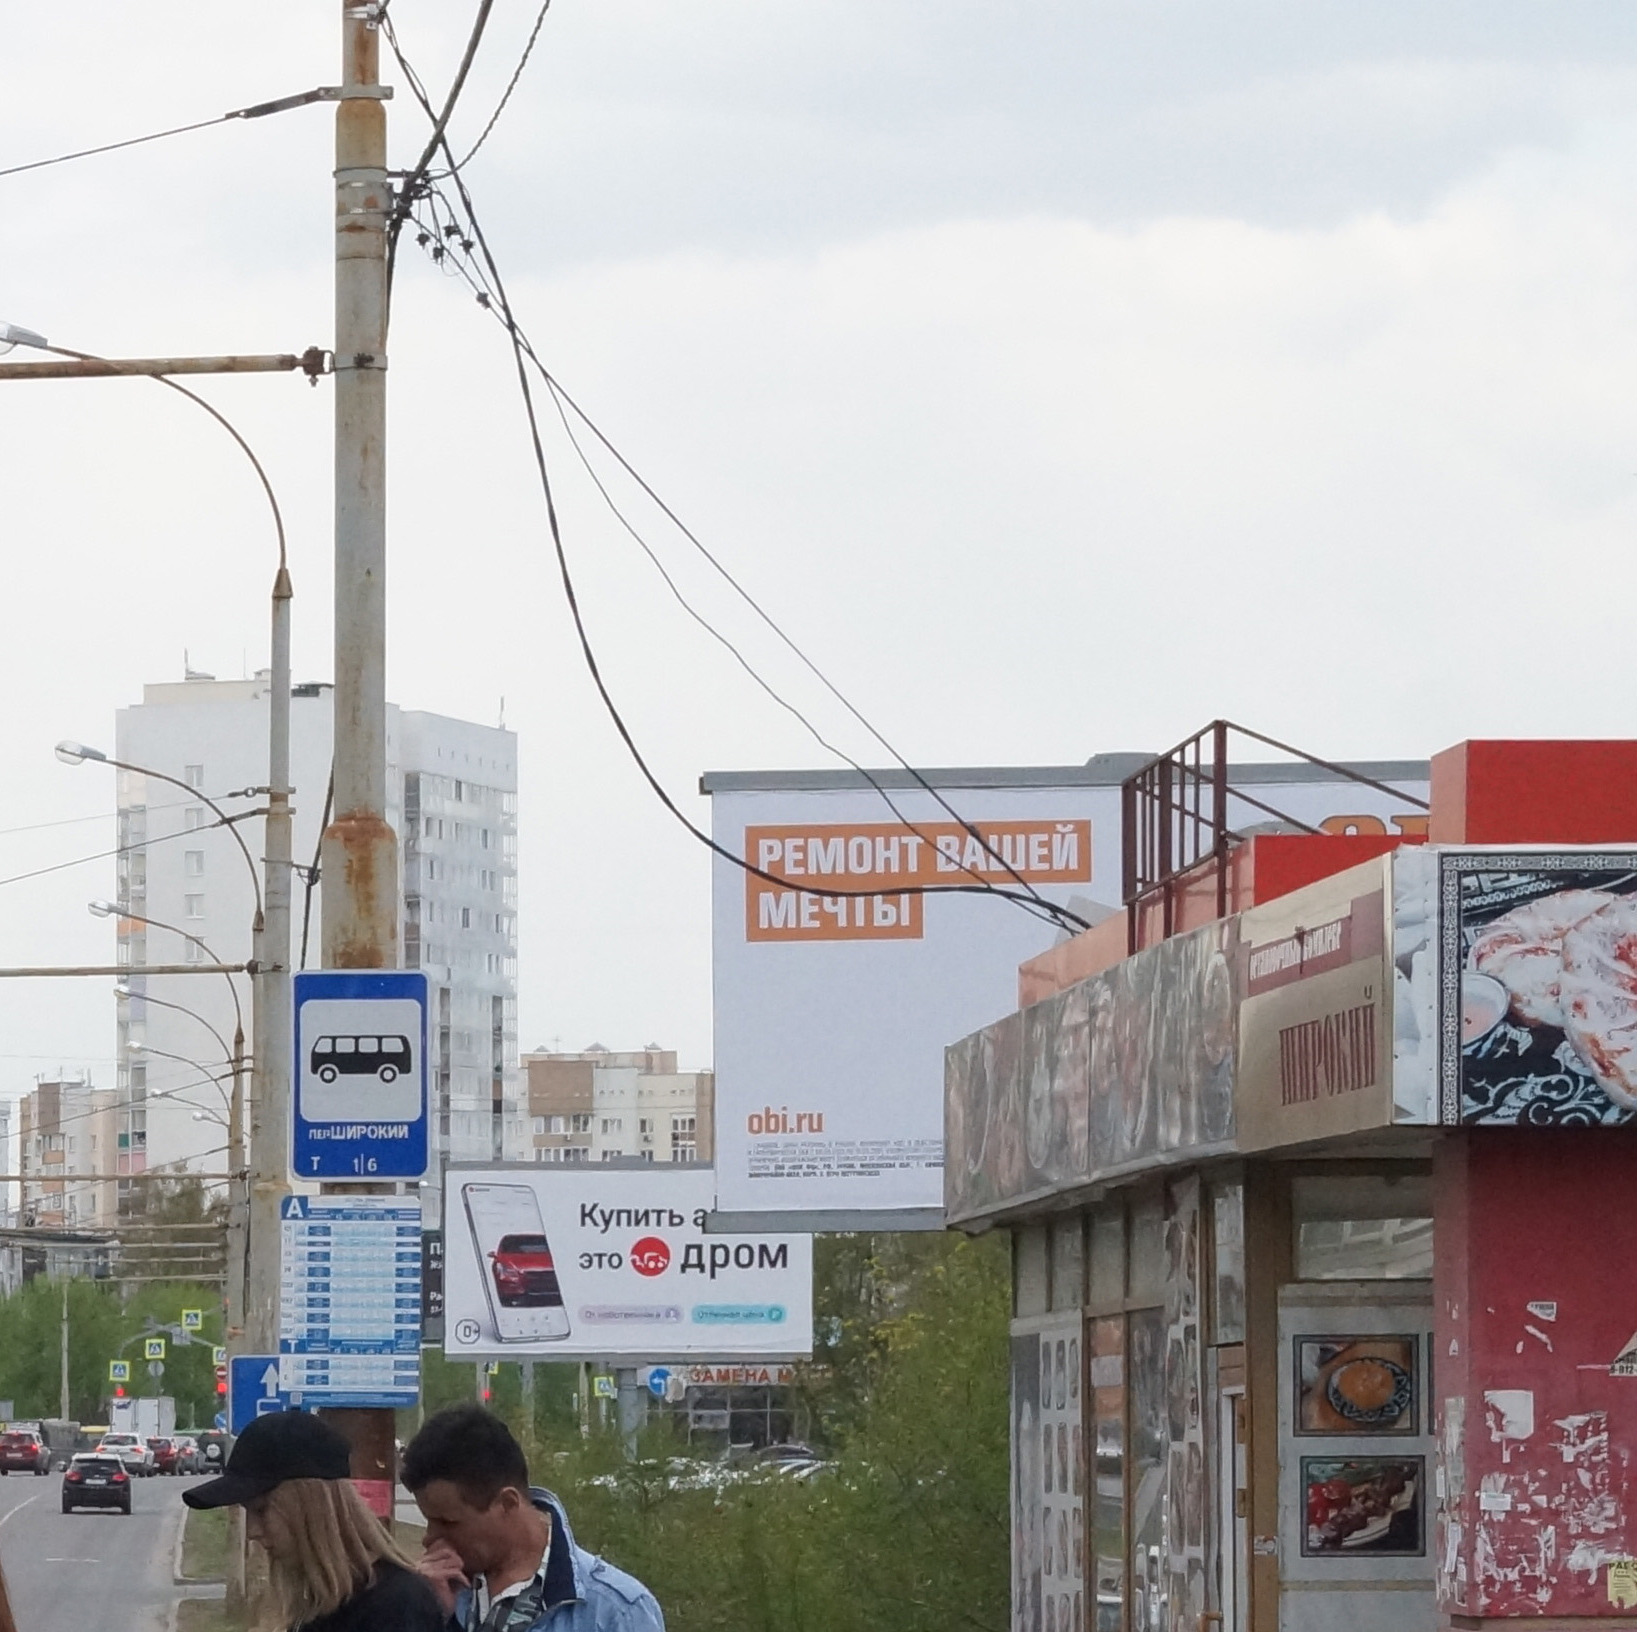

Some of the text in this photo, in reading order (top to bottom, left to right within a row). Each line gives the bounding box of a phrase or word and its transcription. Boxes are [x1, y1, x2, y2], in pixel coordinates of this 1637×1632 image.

[758, 823, 1079, 876] РЕМОНТ ВАШЕЙ
[758, 891, 911, 929] МЕЧТЫ
[747, 1105, 825, 1135] obi.ru
[579, 1202, 685, 1235] Купить
[578, 1243, 789, 1280] это дром
[690, 1367, 769, 1384] ЗАМЕНА
